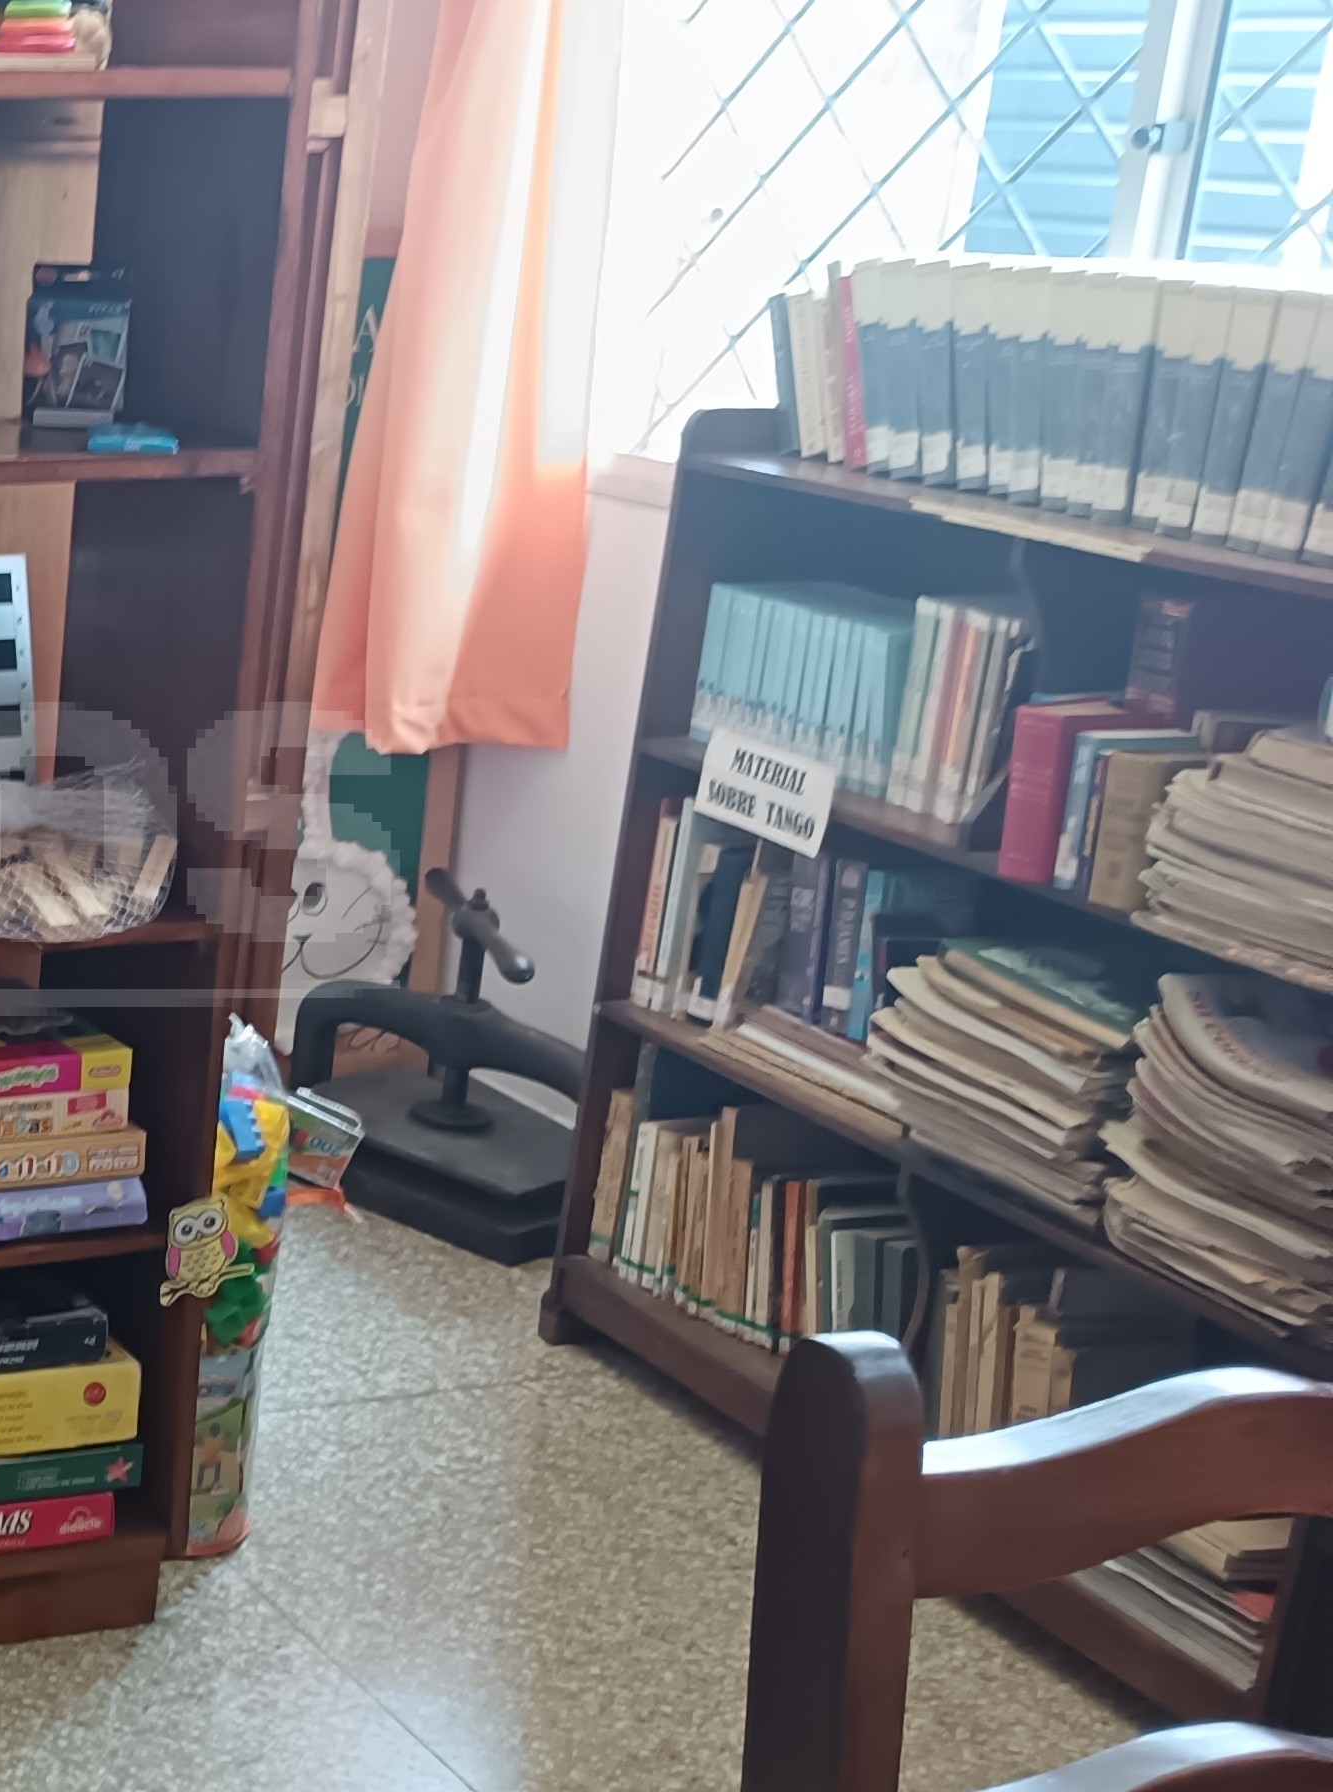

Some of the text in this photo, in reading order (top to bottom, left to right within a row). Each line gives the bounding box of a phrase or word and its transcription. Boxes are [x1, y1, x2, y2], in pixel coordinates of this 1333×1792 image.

[729, 747, 808, 797] MATERIAL
[706, 779, 817, 841] SOBRE TANGO
